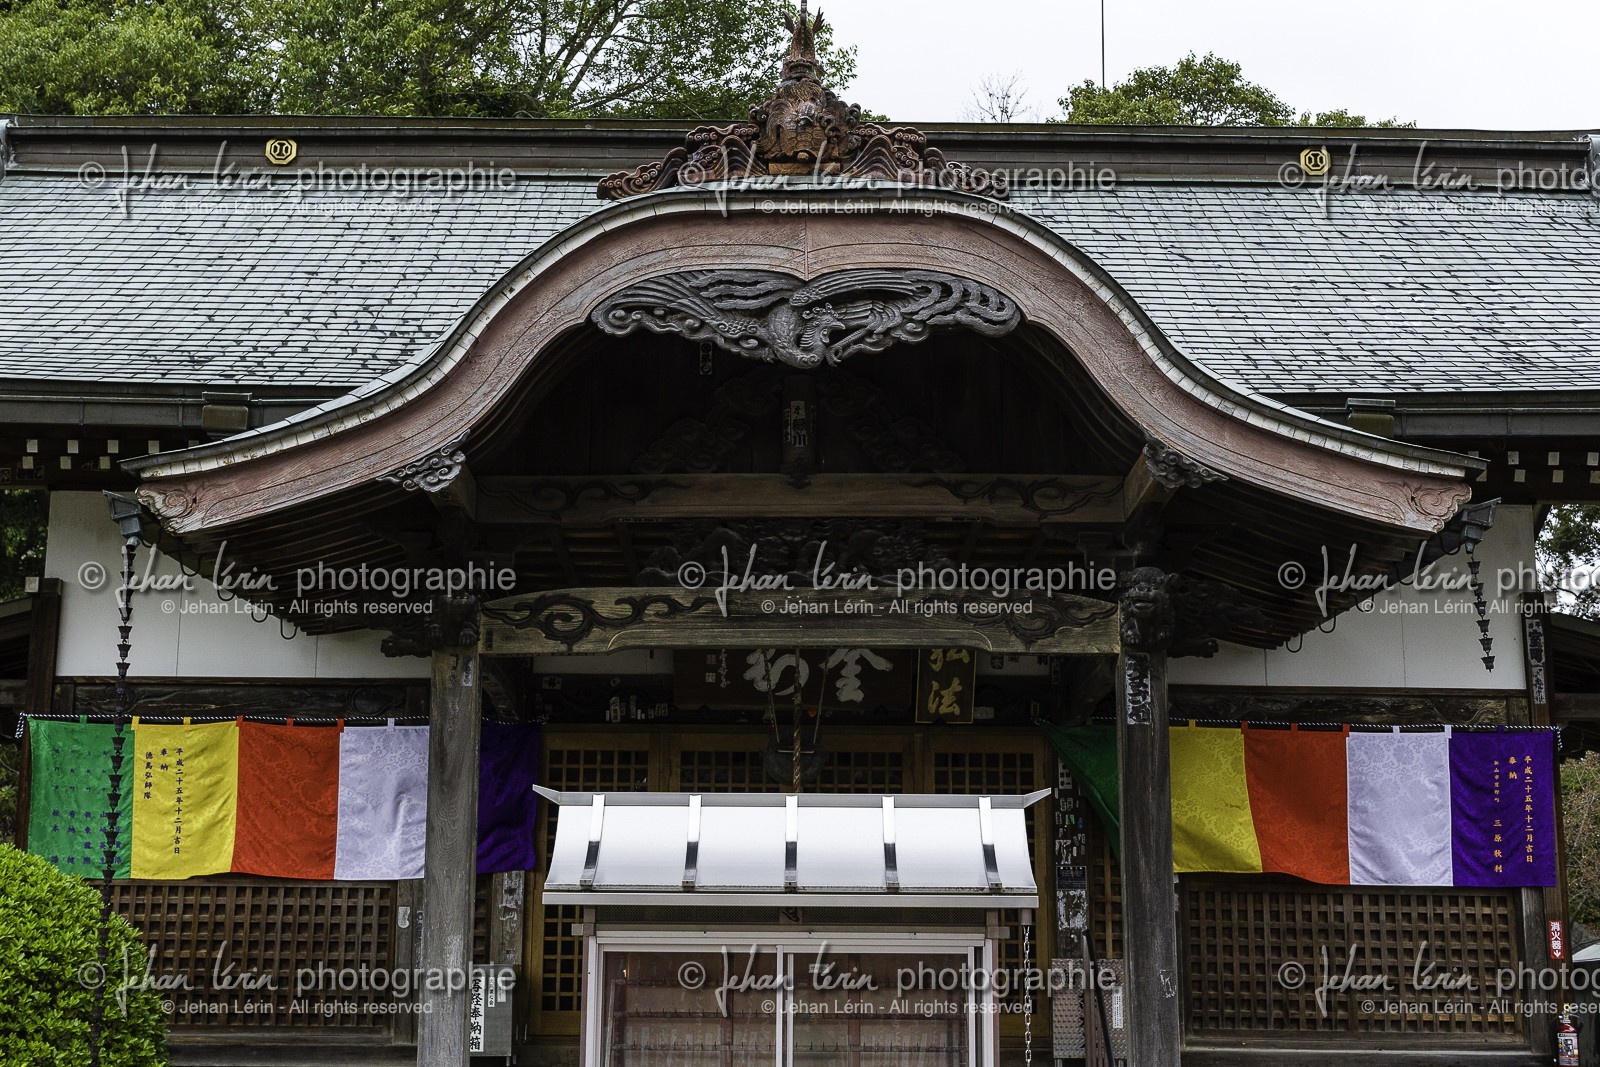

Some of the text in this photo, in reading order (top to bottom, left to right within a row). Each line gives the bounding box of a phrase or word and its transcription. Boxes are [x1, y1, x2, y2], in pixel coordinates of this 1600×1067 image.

[173, 747, 184, 855] 平成二十五年十二月吉日
[1524, 755, 1533, 863] 平成二十五年十二月吉日
[1551, 921, 1562, 950] 消火器
